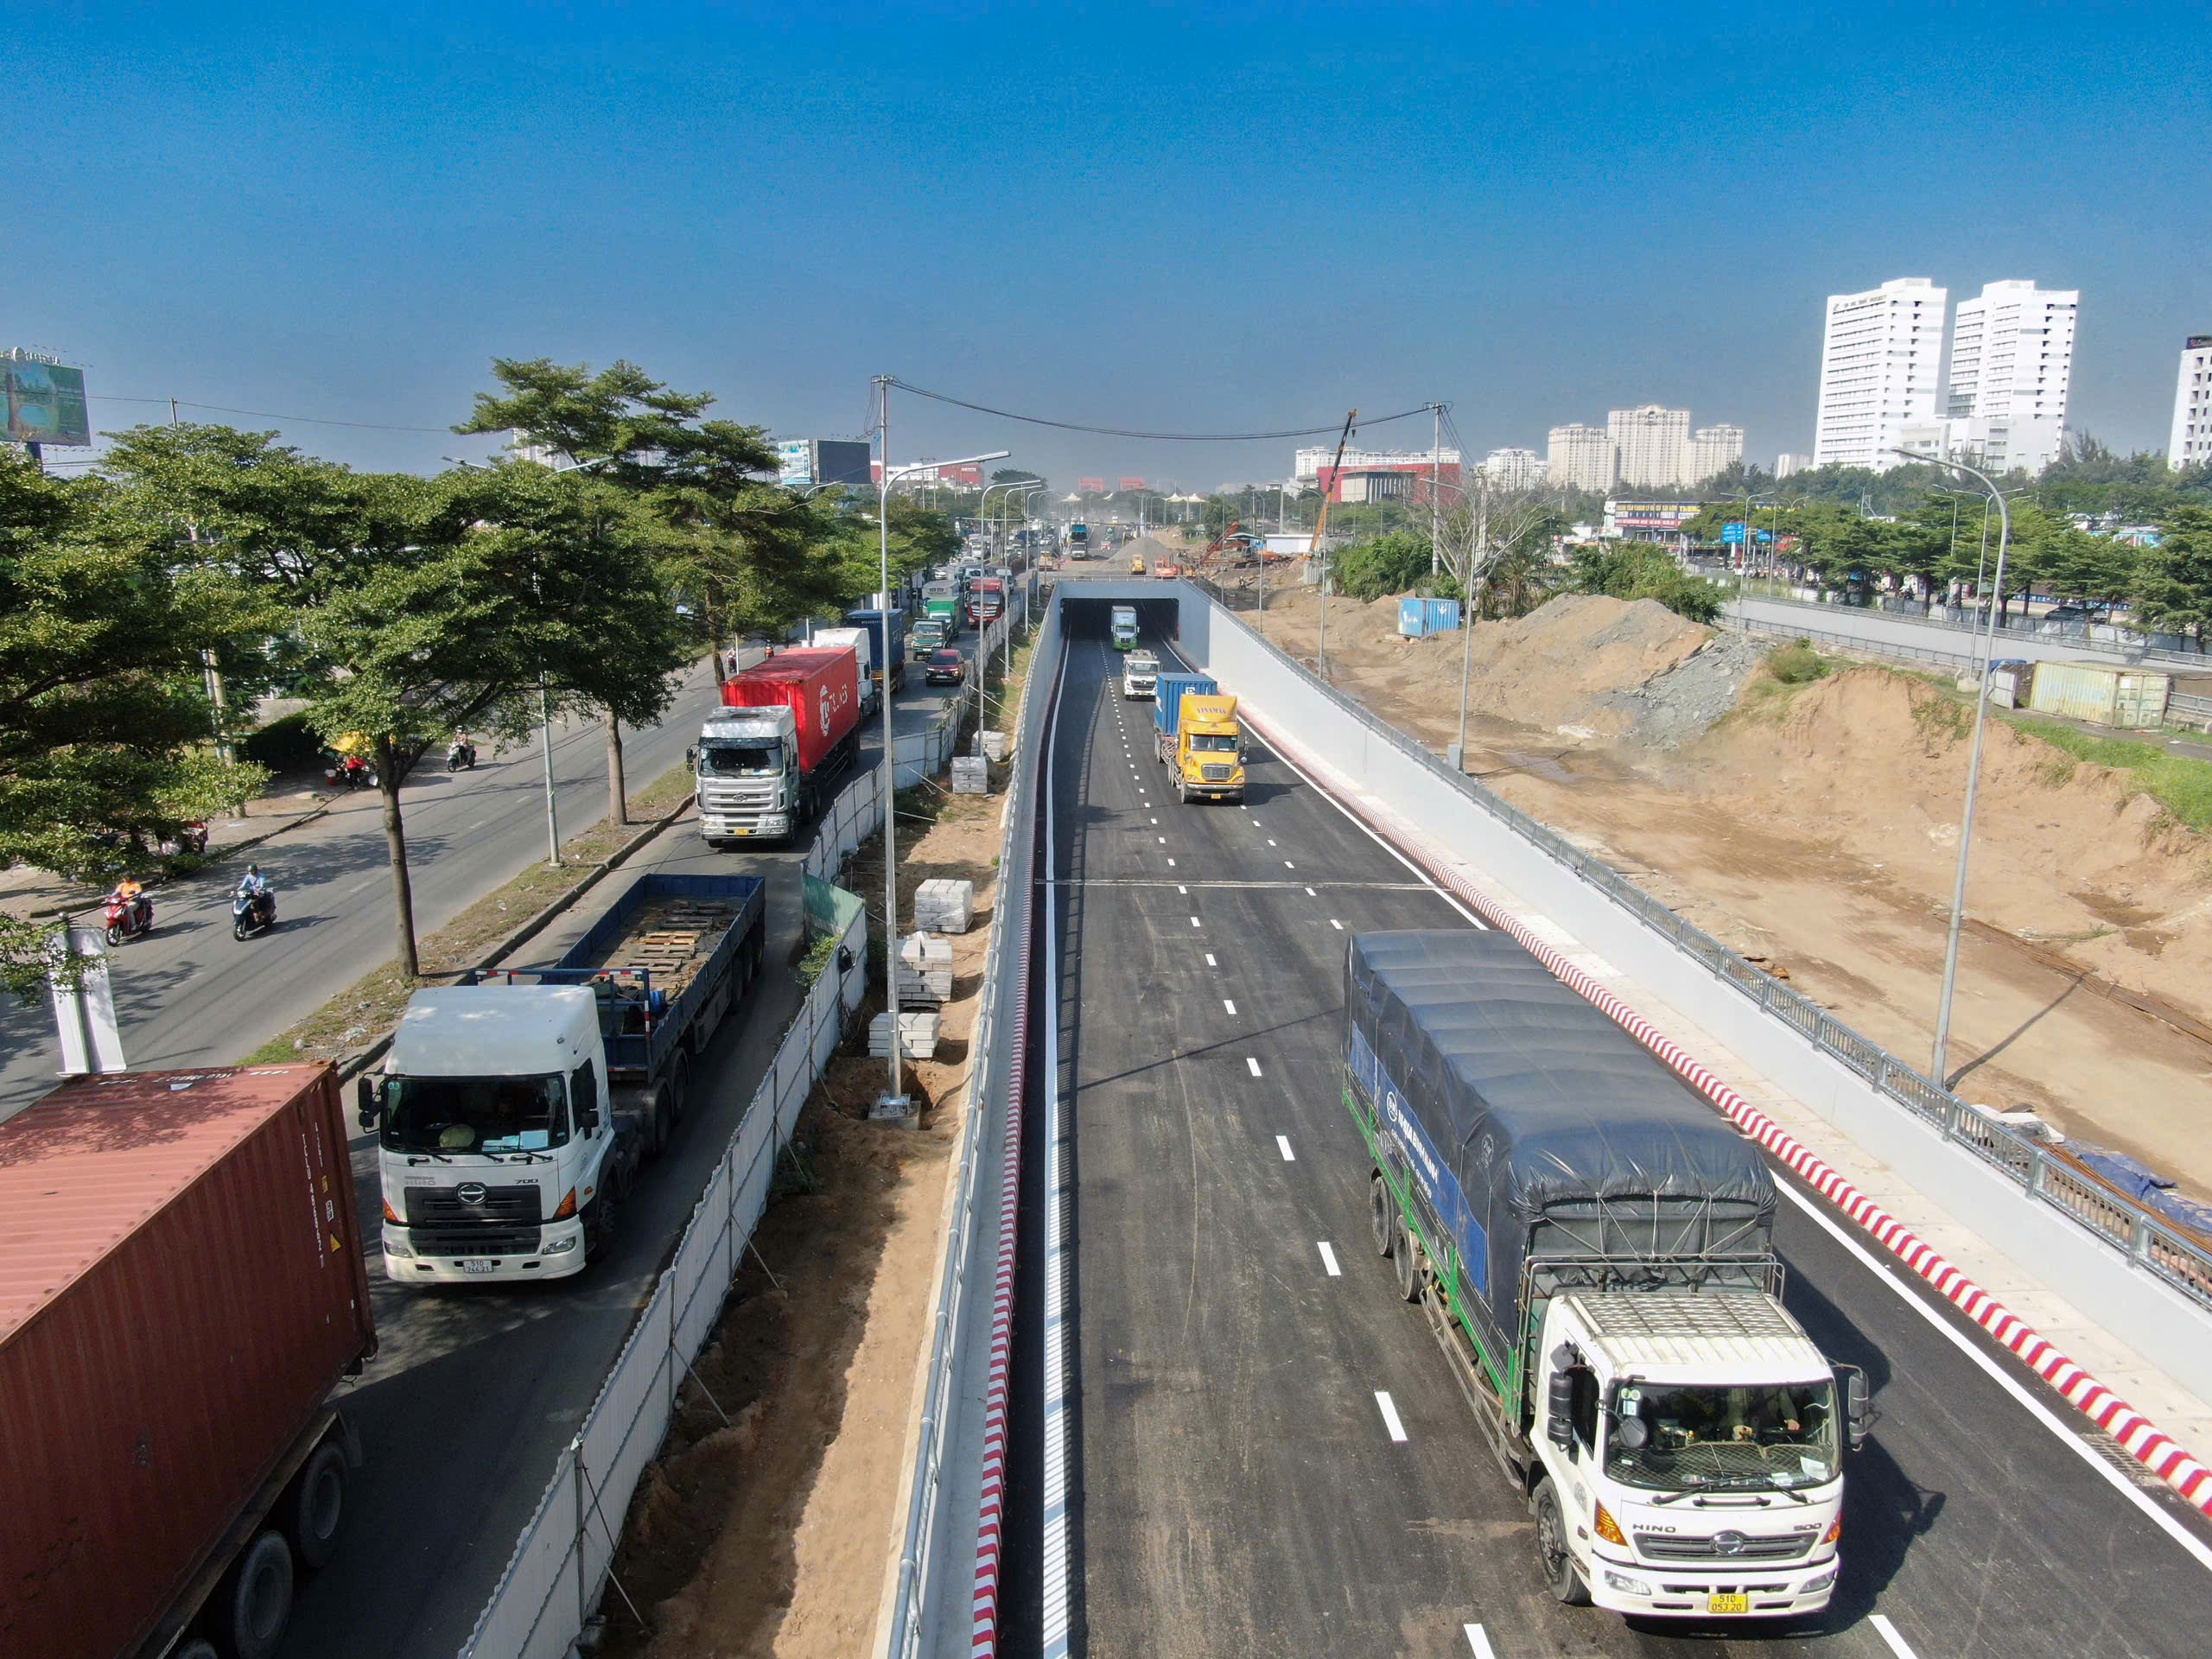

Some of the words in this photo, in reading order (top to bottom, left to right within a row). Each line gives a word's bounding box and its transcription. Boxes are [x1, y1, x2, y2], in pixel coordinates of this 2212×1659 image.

[1632, 1523, 1676, 1533] HINO
[1793, 1522, 1822, 1531] 500
[1719, 1594, 1735, 1603] 51D
